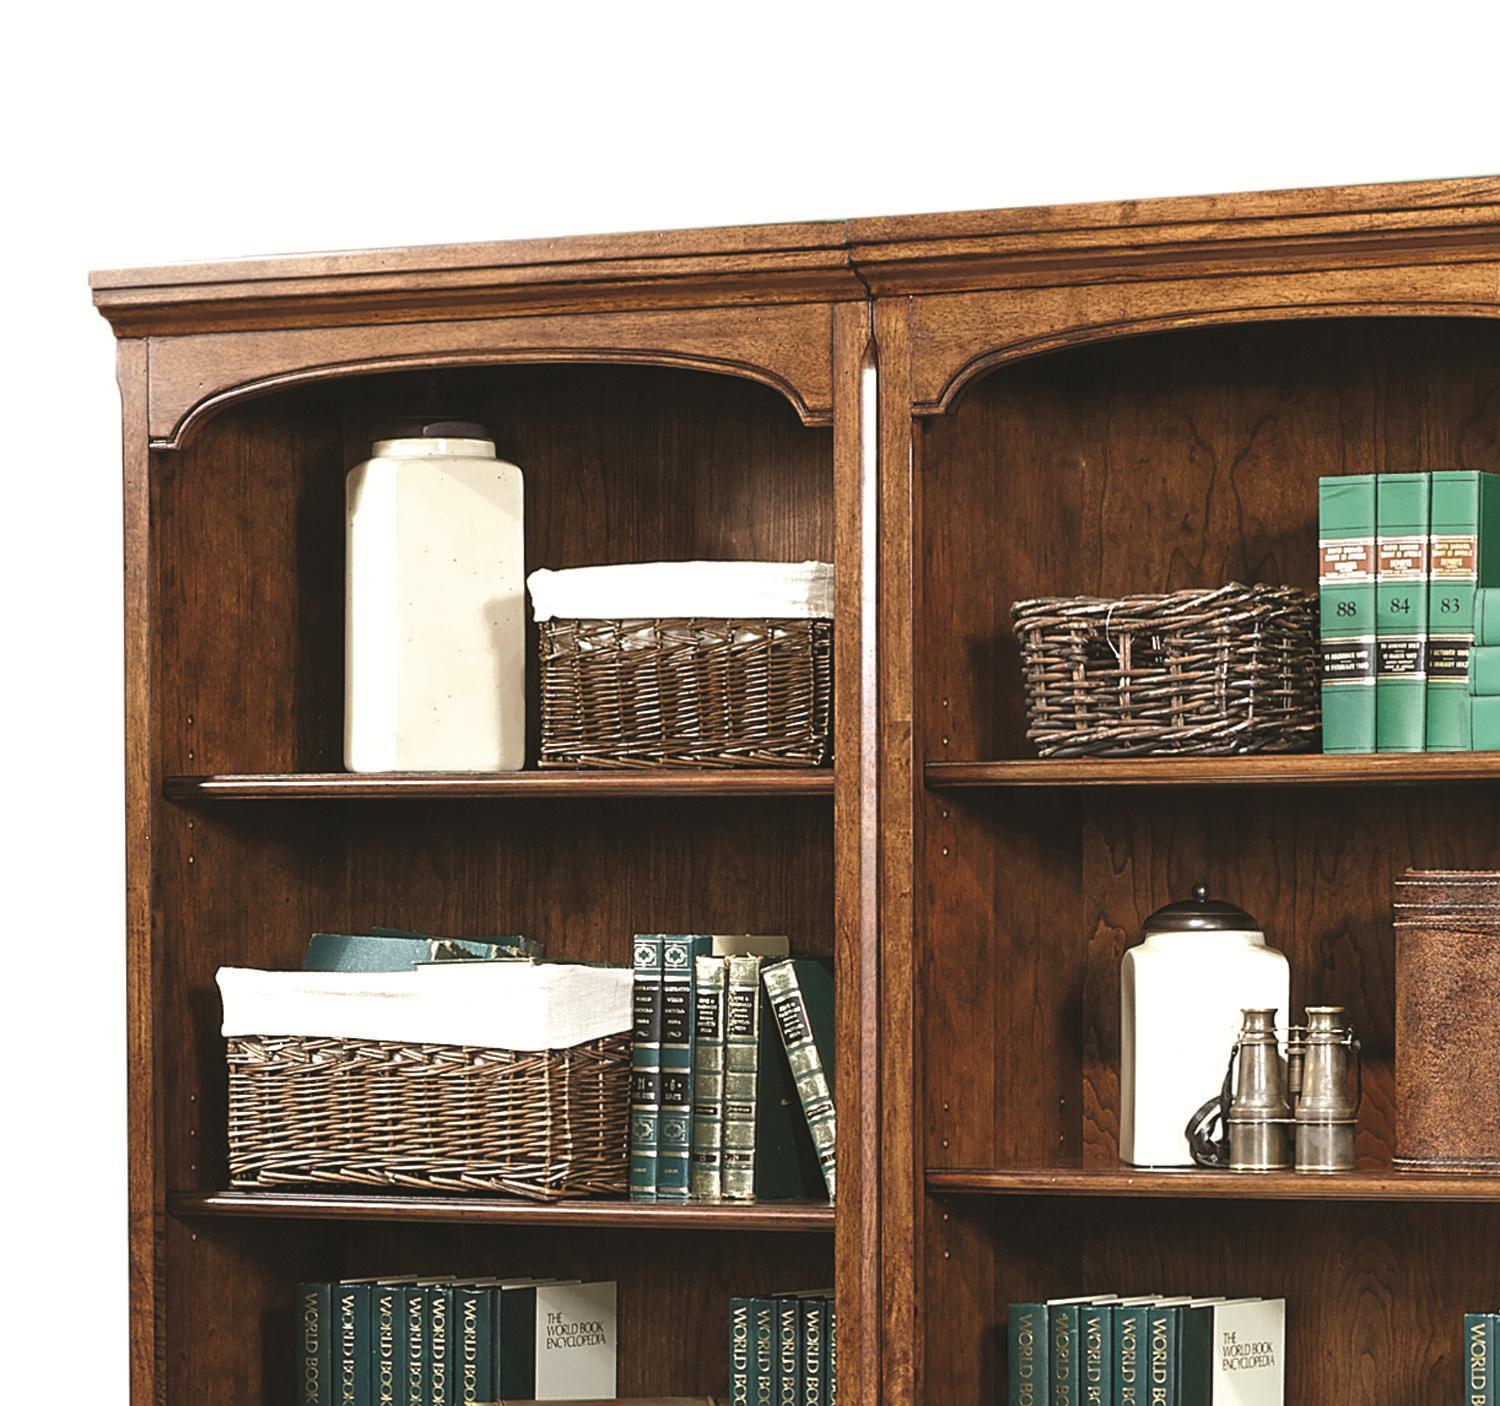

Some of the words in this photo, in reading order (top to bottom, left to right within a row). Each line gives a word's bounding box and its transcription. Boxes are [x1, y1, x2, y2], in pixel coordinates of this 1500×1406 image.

[1336, 601, 1357, 617] 88
[1390, 598, 1410, 614] 84
[1440, 598, 1460, 614] 83
[305, 1293, 319, 1354] WORLD
[342, 1295, 355, 1357] WORLD
[379, 1296, 393, 1358] WORLD
[409, 1297, 422, 1359] WORLD
[432, 1298, 445, 1360] WORLD
[463, 1299, 477, 1361] WORLD
[546, 1333, 606, 1349] ENCYCLOPEDIA
[547, 1312, 562, 1324] THE
[547, 1322, 578, 1337] WORLD
[580, 1321, 604, 1334] BOOK
[733, 1307, 748, 1370] WORLD
[757, 1309, 771, 1372] WORLD
[781, 1310, 795, 1373] WORLD
[806, 1310, 820, 1374] WORLD
[1019, 1314, 1033, 1378] WORLD
[1056, 1314, 1070, 1380] WORLD
[1223, 1331, 1237, 1344] THE
[305, 1357, 319, 1404] BOOK
[1087, 1317, 1101, 1382] WORLD
[1121, 1318, 1136, 1383] WORLD
[1152, 1318, 1167, 1384] WORLD
[1470, 1323, 1486, 1390] WORLD
[342, 1359, 355, 1406] BOOK
[379, 1360, 393, 1406] BOOK
[463, 1364, 477, 1402] BOO
